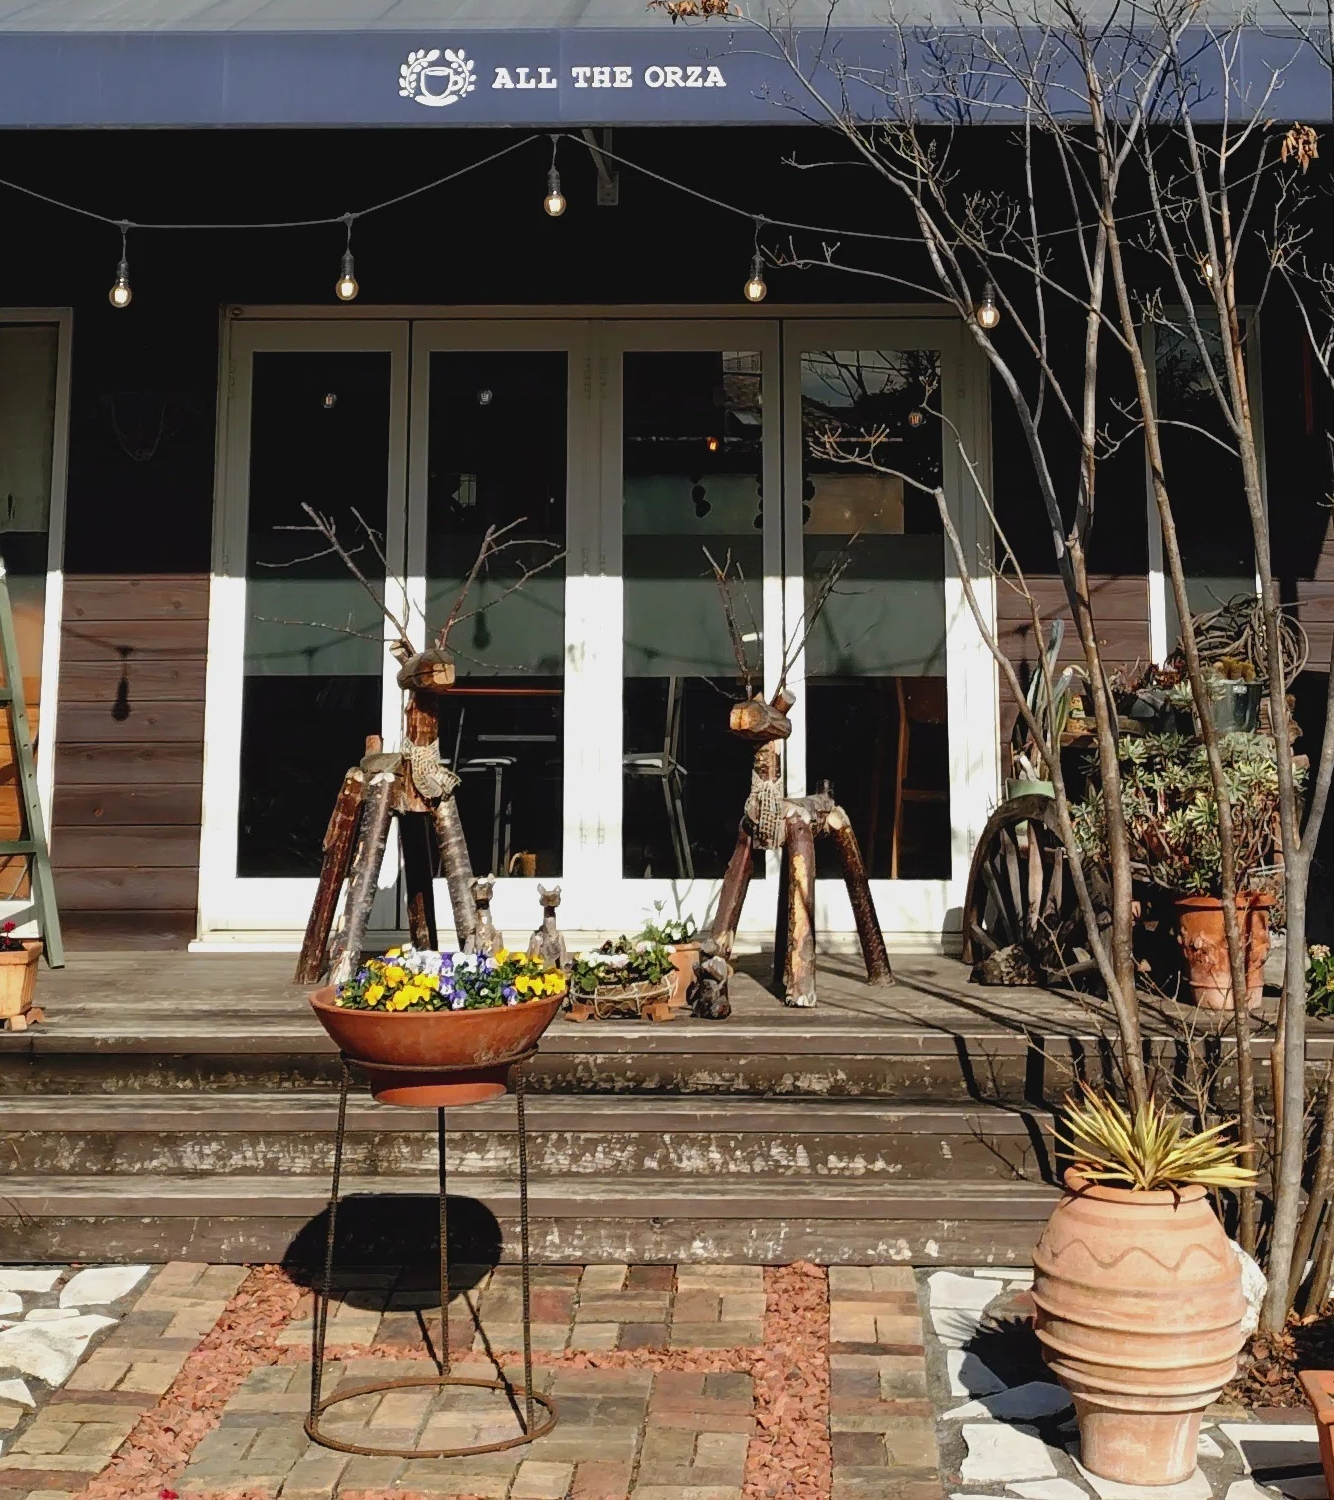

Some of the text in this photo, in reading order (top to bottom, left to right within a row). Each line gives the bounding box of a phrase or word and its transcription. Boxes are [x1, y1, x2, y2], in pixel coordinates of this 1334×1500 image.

[491, 65, 727, 89] ALL THE ORZA
